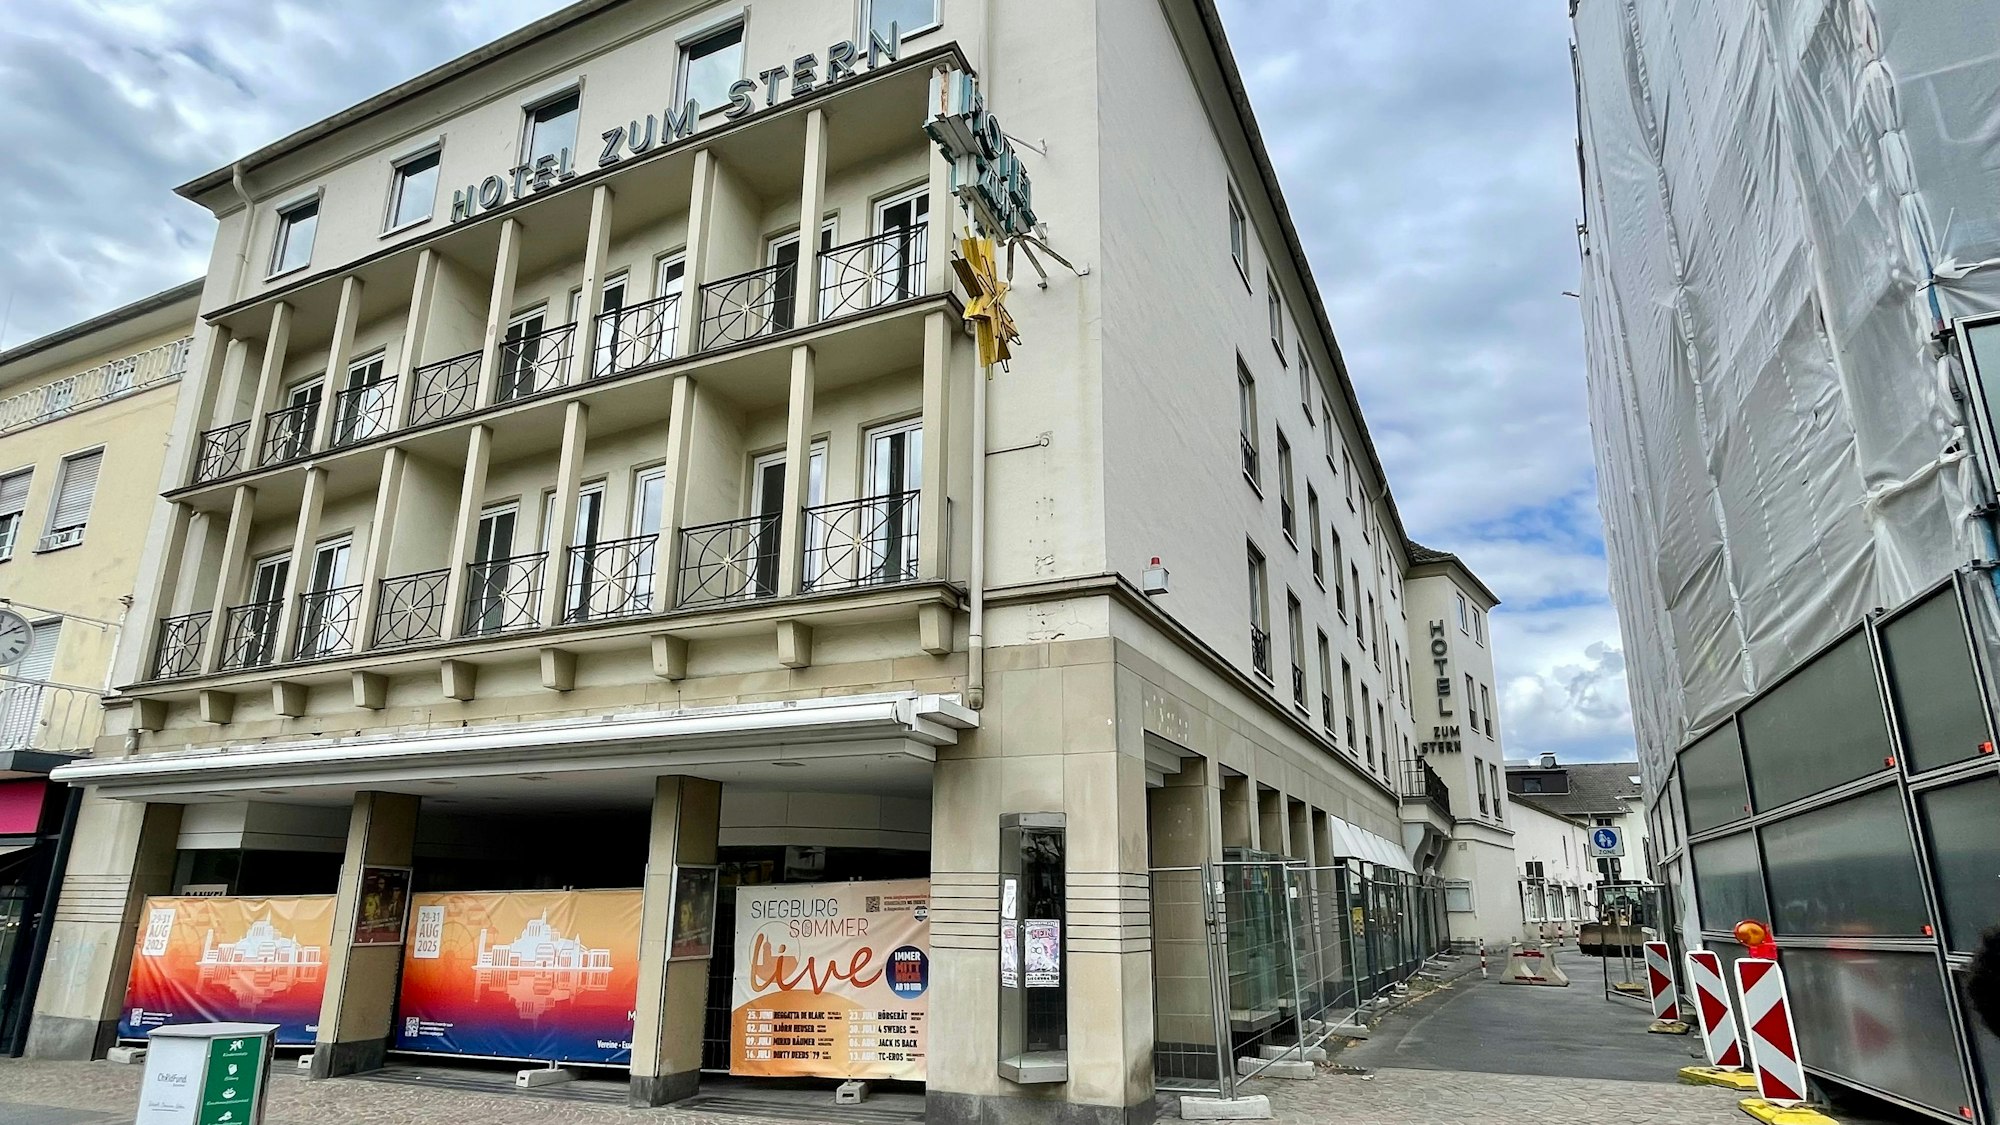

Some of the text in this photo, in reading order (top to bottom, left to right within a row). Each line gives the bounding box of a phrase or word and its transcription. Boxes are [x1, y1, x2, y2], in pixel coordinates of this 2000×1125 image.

[450, 20, 899, 224] HOTEL ZUM STERN
[1429, 619, 1453, 718] HOTEL
[1433, 725, 1460, 738] ZUM
[1421, 740, 1462, 753] STERN
[751, 898, 838, 919] SIEGBURG
[148, 925, 169, 938] AUG
[419, 924, 440, 938] AUG
[789, 918, 869, 938] SOMMER
[146, 940, 164, 951] 2025
[417, 940, 437, 952] 2025
[894, 951, 921, 961] IMMER
[751, 933, 883, 995] live
[884, 1025, 907, 1033] SWEDES
[878, 1039, 893, 1047] JACK
[895, 1039, 900, 1047] IS
[902, 1039, 917, 1047] BACK
[878, 1052, 904, 1060] TC-EROS
